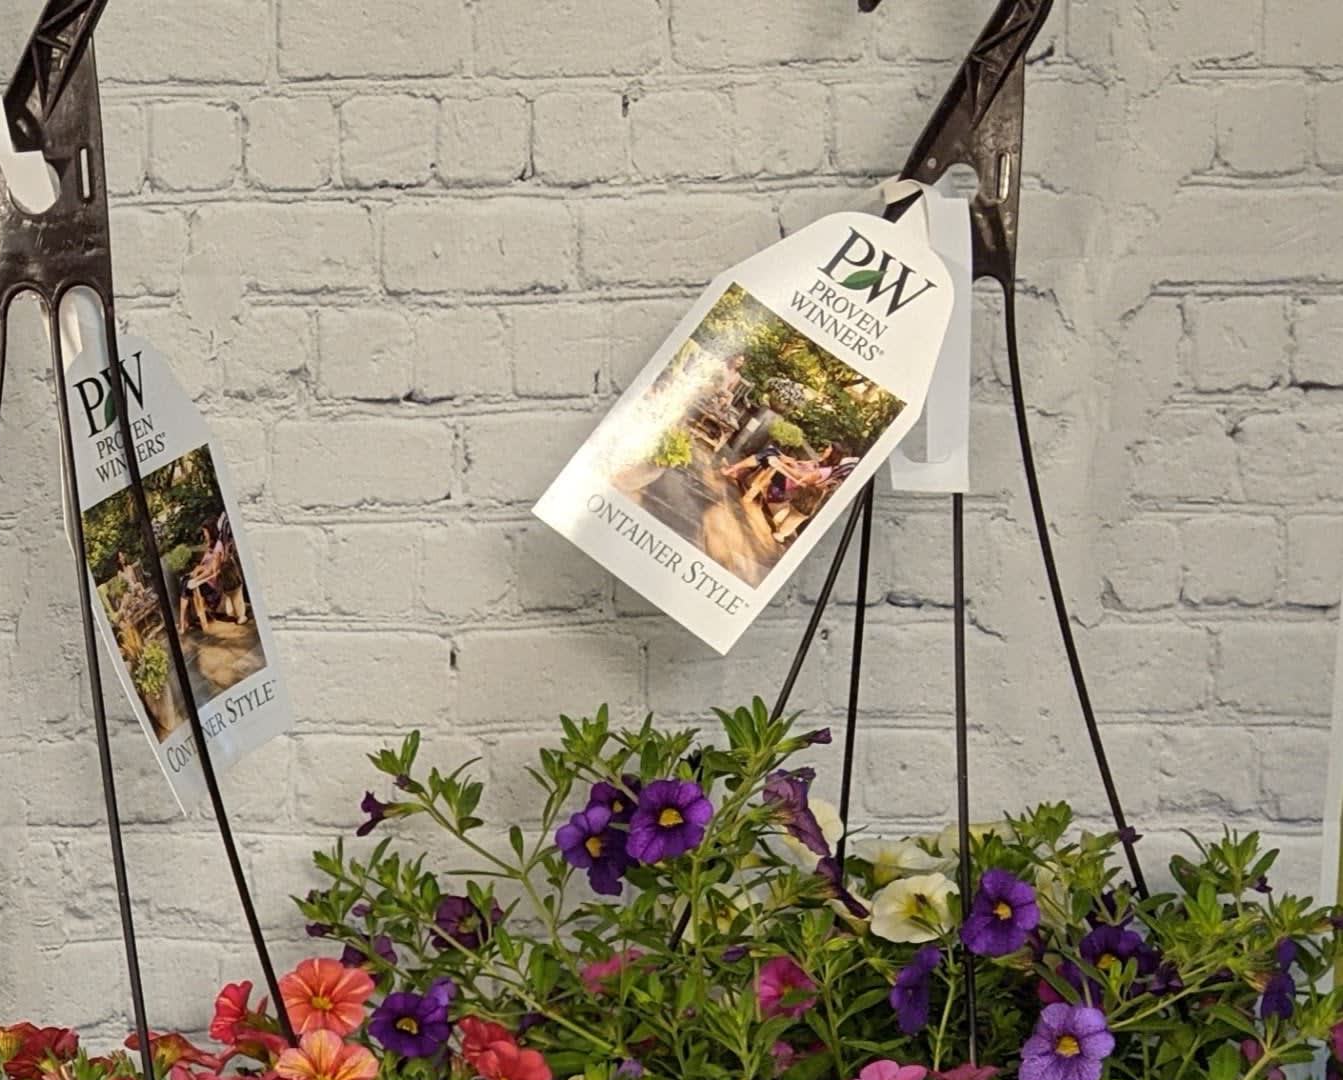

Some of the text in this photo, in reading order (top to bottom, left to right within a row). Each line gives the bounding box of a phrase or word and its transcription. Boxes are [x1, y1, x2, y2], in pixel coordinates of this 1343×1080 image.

[809, 279, 889, 340] PROVEN
[96, 414, 155, 459] PROEN
[96, 431, 165, 483] WINERS
[580, 492, 683, 574] ONTAINER
